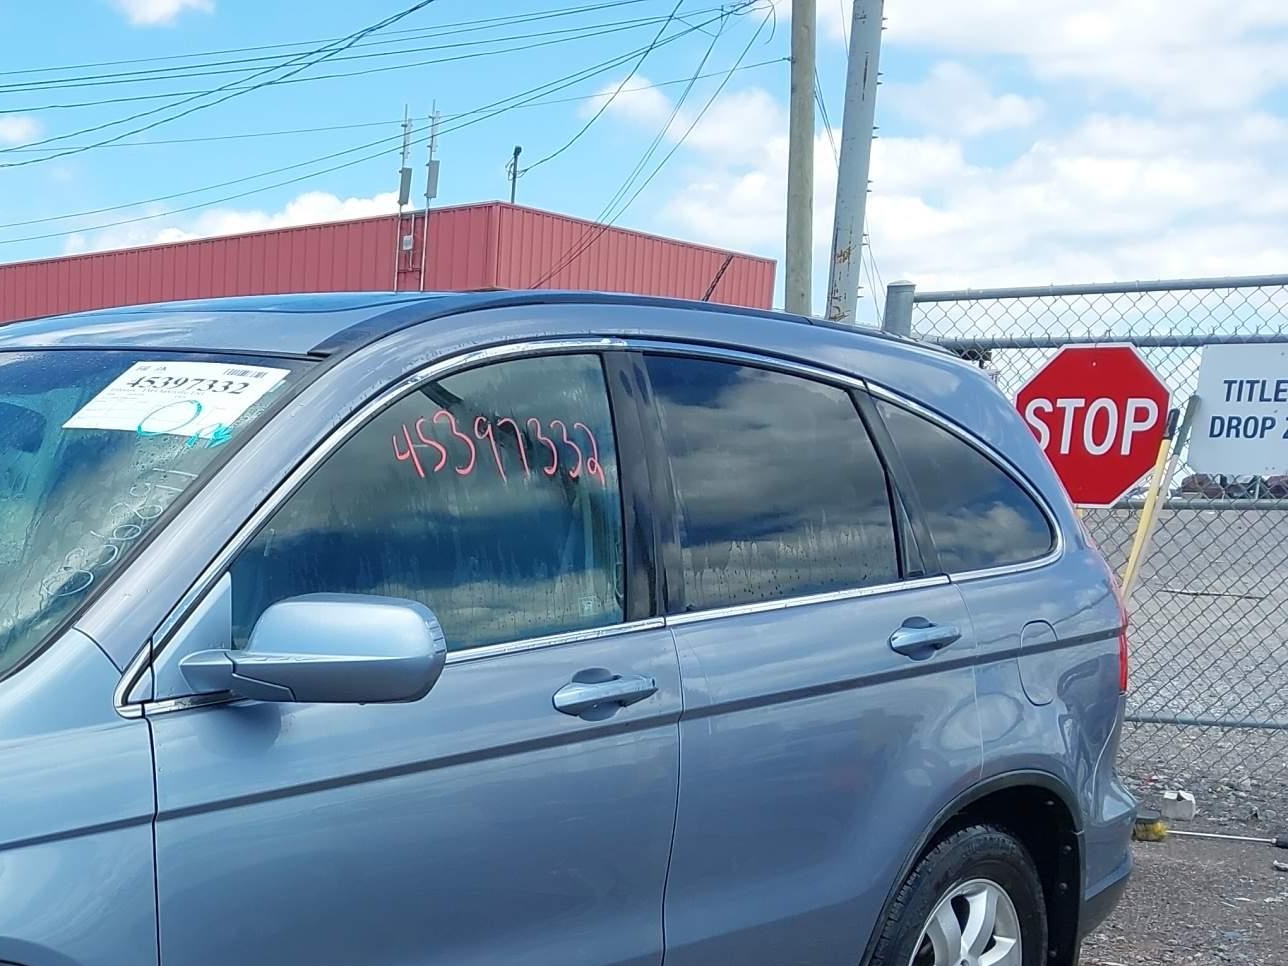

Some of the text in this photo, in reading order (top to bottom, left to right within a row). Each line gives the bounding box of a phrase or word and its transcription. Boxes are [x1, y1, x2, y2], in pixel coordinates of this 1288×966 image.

[126, 376, 250, 395] 45397332
[1223, 379, 1288, 402] TITLE
[1024, 397, 1159, 456] STOP
[1209, 415, 1277, 439] DROP
[393, 409, 605, 488] 45397332
